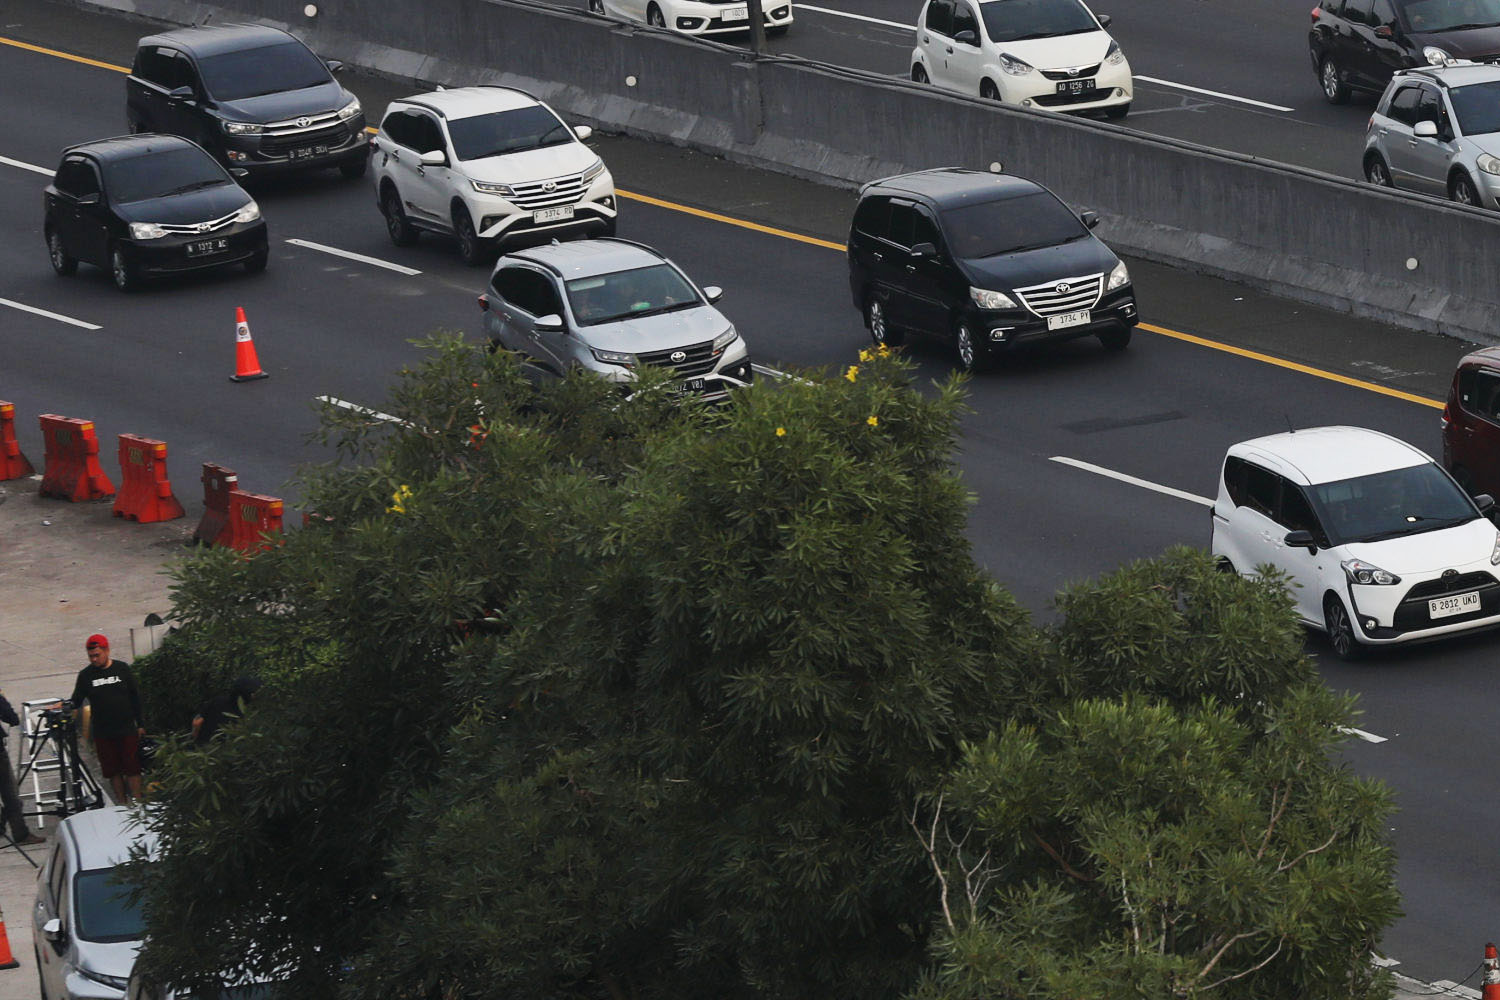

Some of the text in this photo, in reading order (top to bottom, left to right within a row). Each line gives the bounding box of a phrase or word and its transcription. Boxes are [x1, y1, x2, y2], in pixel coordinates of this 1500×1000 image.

[1058, 83, 1066, 91] AD
[1069, 81, 1083, 90] 1256
[1080, 311, 1089, 320] PY
[1431, 602, 1437, 612] B
[1440, 599, 1459, 610] 2812
[1462, 595, 1478, 606] UKD
